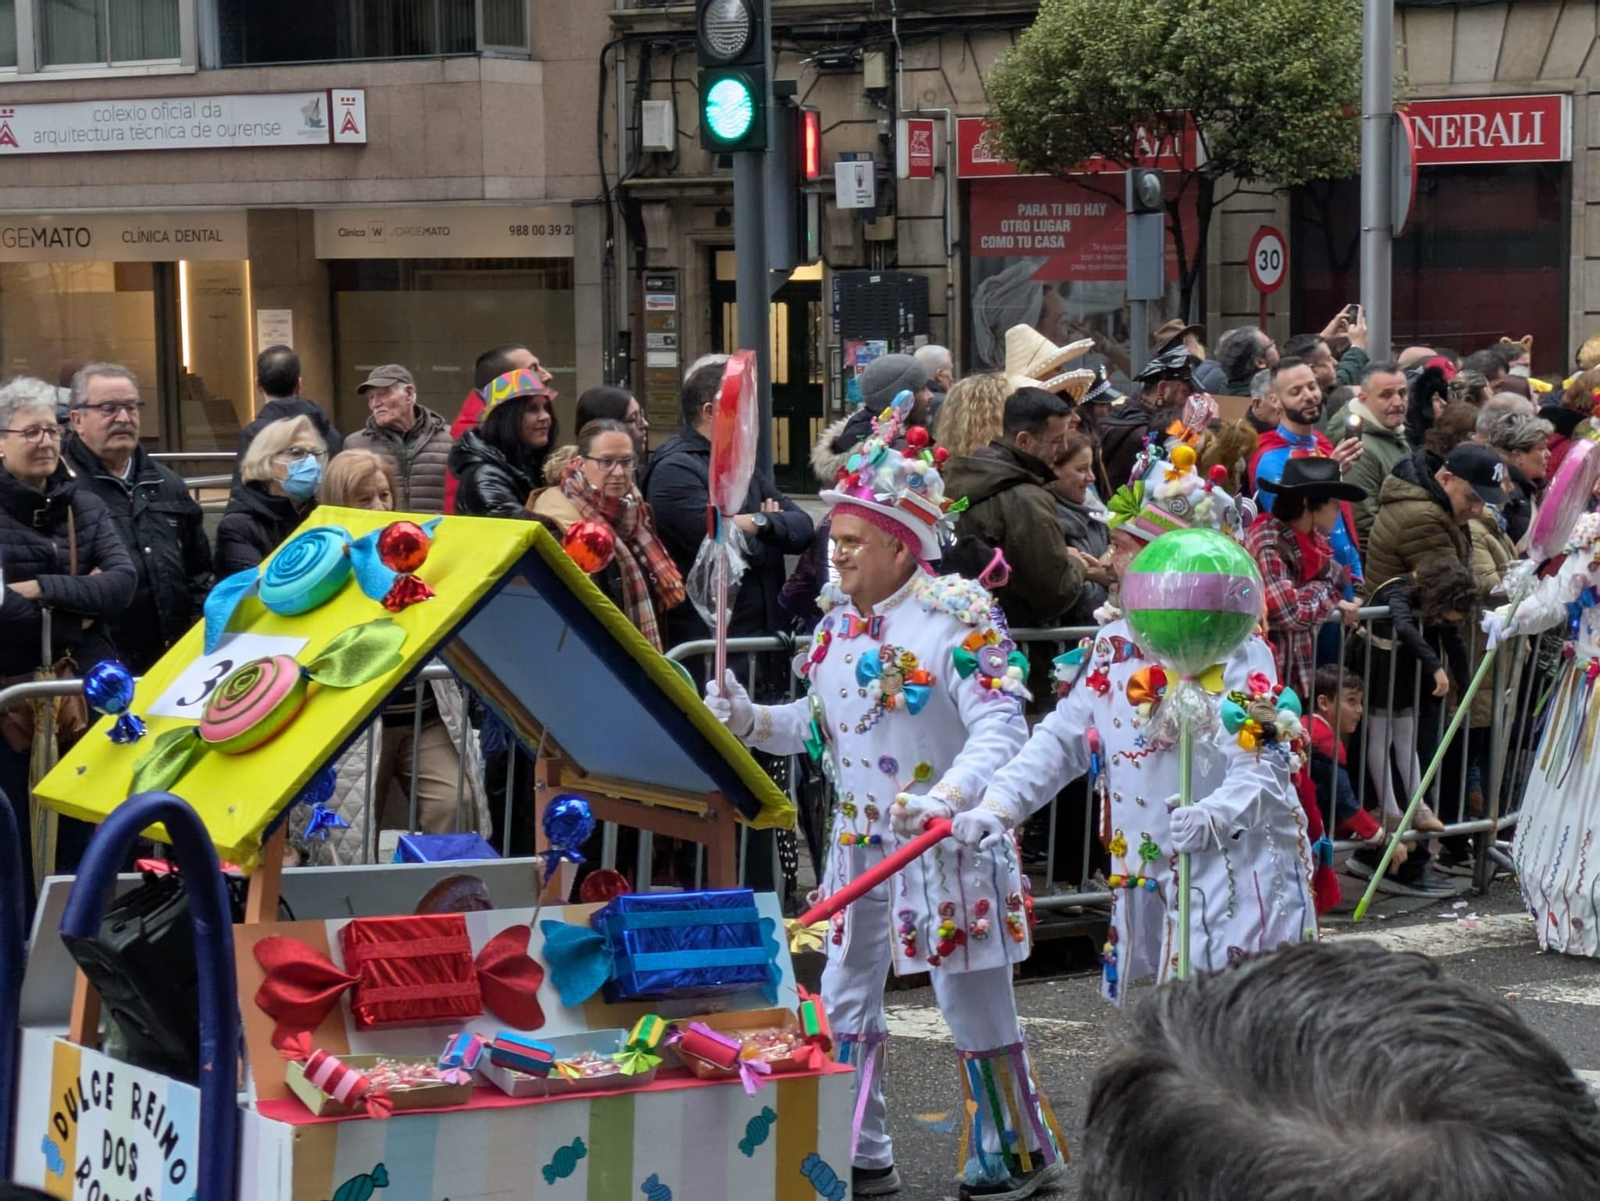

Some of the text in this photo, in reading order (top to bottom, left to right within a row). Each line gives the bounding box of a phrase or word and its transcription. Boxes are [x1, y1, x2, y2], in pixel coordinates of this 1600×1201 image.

[93, 101, 222, 122] colexio oficial da
[33, 126, 125, 147] arquitectura
[130, 122, 186, 141] técnica
[190, 121, 212, 138] de
[216, 120, 282, 137] ourense
[1411, 111, 1545, 149] NERALI
[1017, 203, 1107, 217] PARA TI NO HAY
[508, 224, 530, 236] 988
[531, 224, 546, 236] 00
[548, 224, 562, 236] 39
[1000, 219, 1071, 233] OTRO LUGAR
[1, 226, 224, 249] GEMATO CLÍNICA DENTAL
[980, 235, 1065, 249] COMO TU CASA
[1259, 249, 1280, 271] 30
[102, 1128, 138, 1182] DOS
